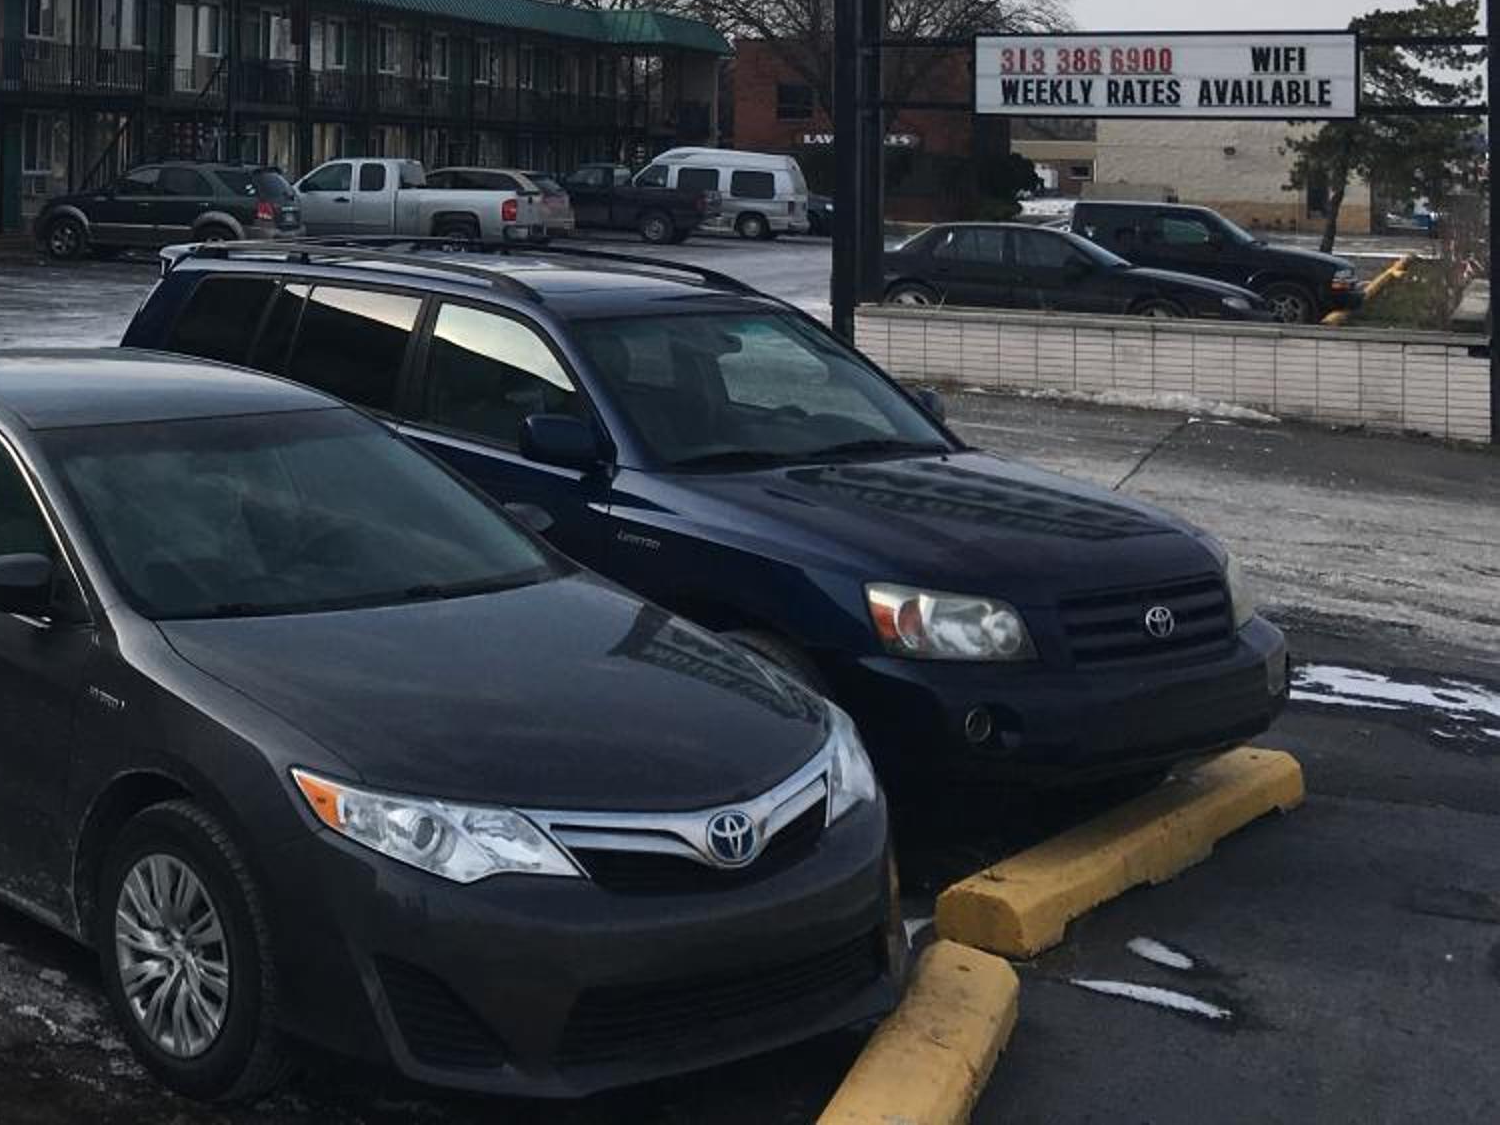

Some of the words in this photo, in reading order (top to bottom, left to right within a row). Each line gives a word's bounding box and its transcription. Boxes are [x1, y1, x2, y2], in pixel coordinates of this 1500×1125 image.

[1001, 47, 1046, 73] 313
[1057, 47, 1103, 73] 386
[1110, 47, 1173, 73] 6900
[1251, 46, 1306, 73] WIFI
[1001, 78, 1094, 106] WEEKLY
[1107, 78, 1181, 106] RATES
[1198, 78, 1332, 106] AVAILABLE
